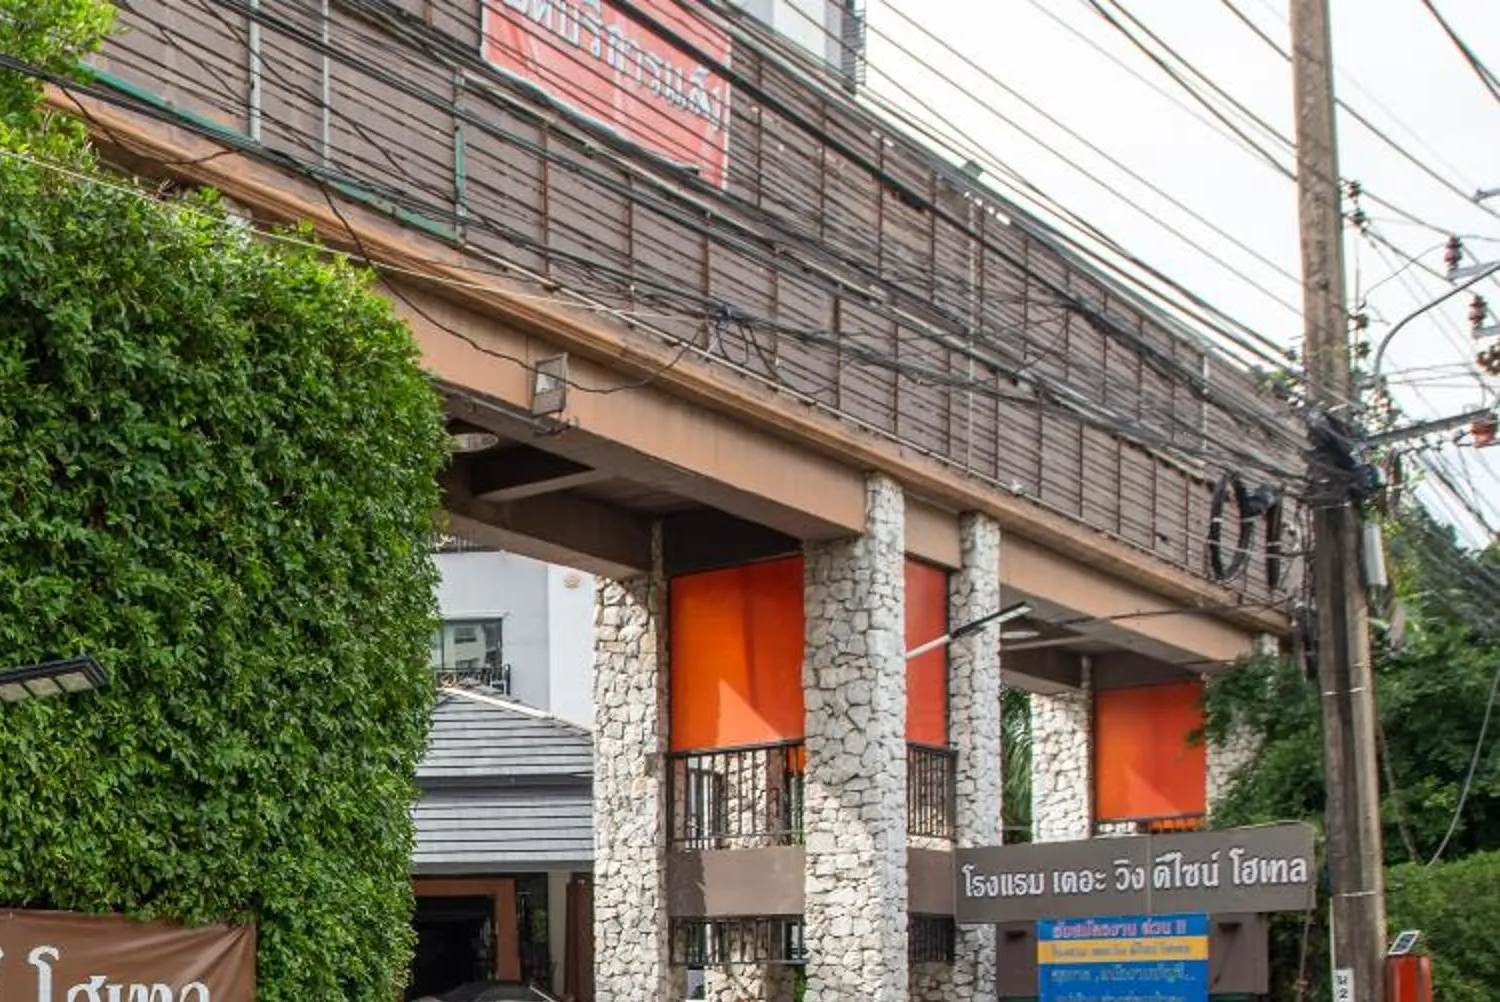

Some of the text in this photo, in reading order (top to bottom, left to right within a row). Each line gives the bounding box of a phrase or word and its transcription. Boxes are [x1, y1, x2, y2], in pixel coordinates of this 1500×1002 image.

[961, 847, 1308, 897] โรงแรม เดอะ วิง ดีไซน์ โฮเทล
